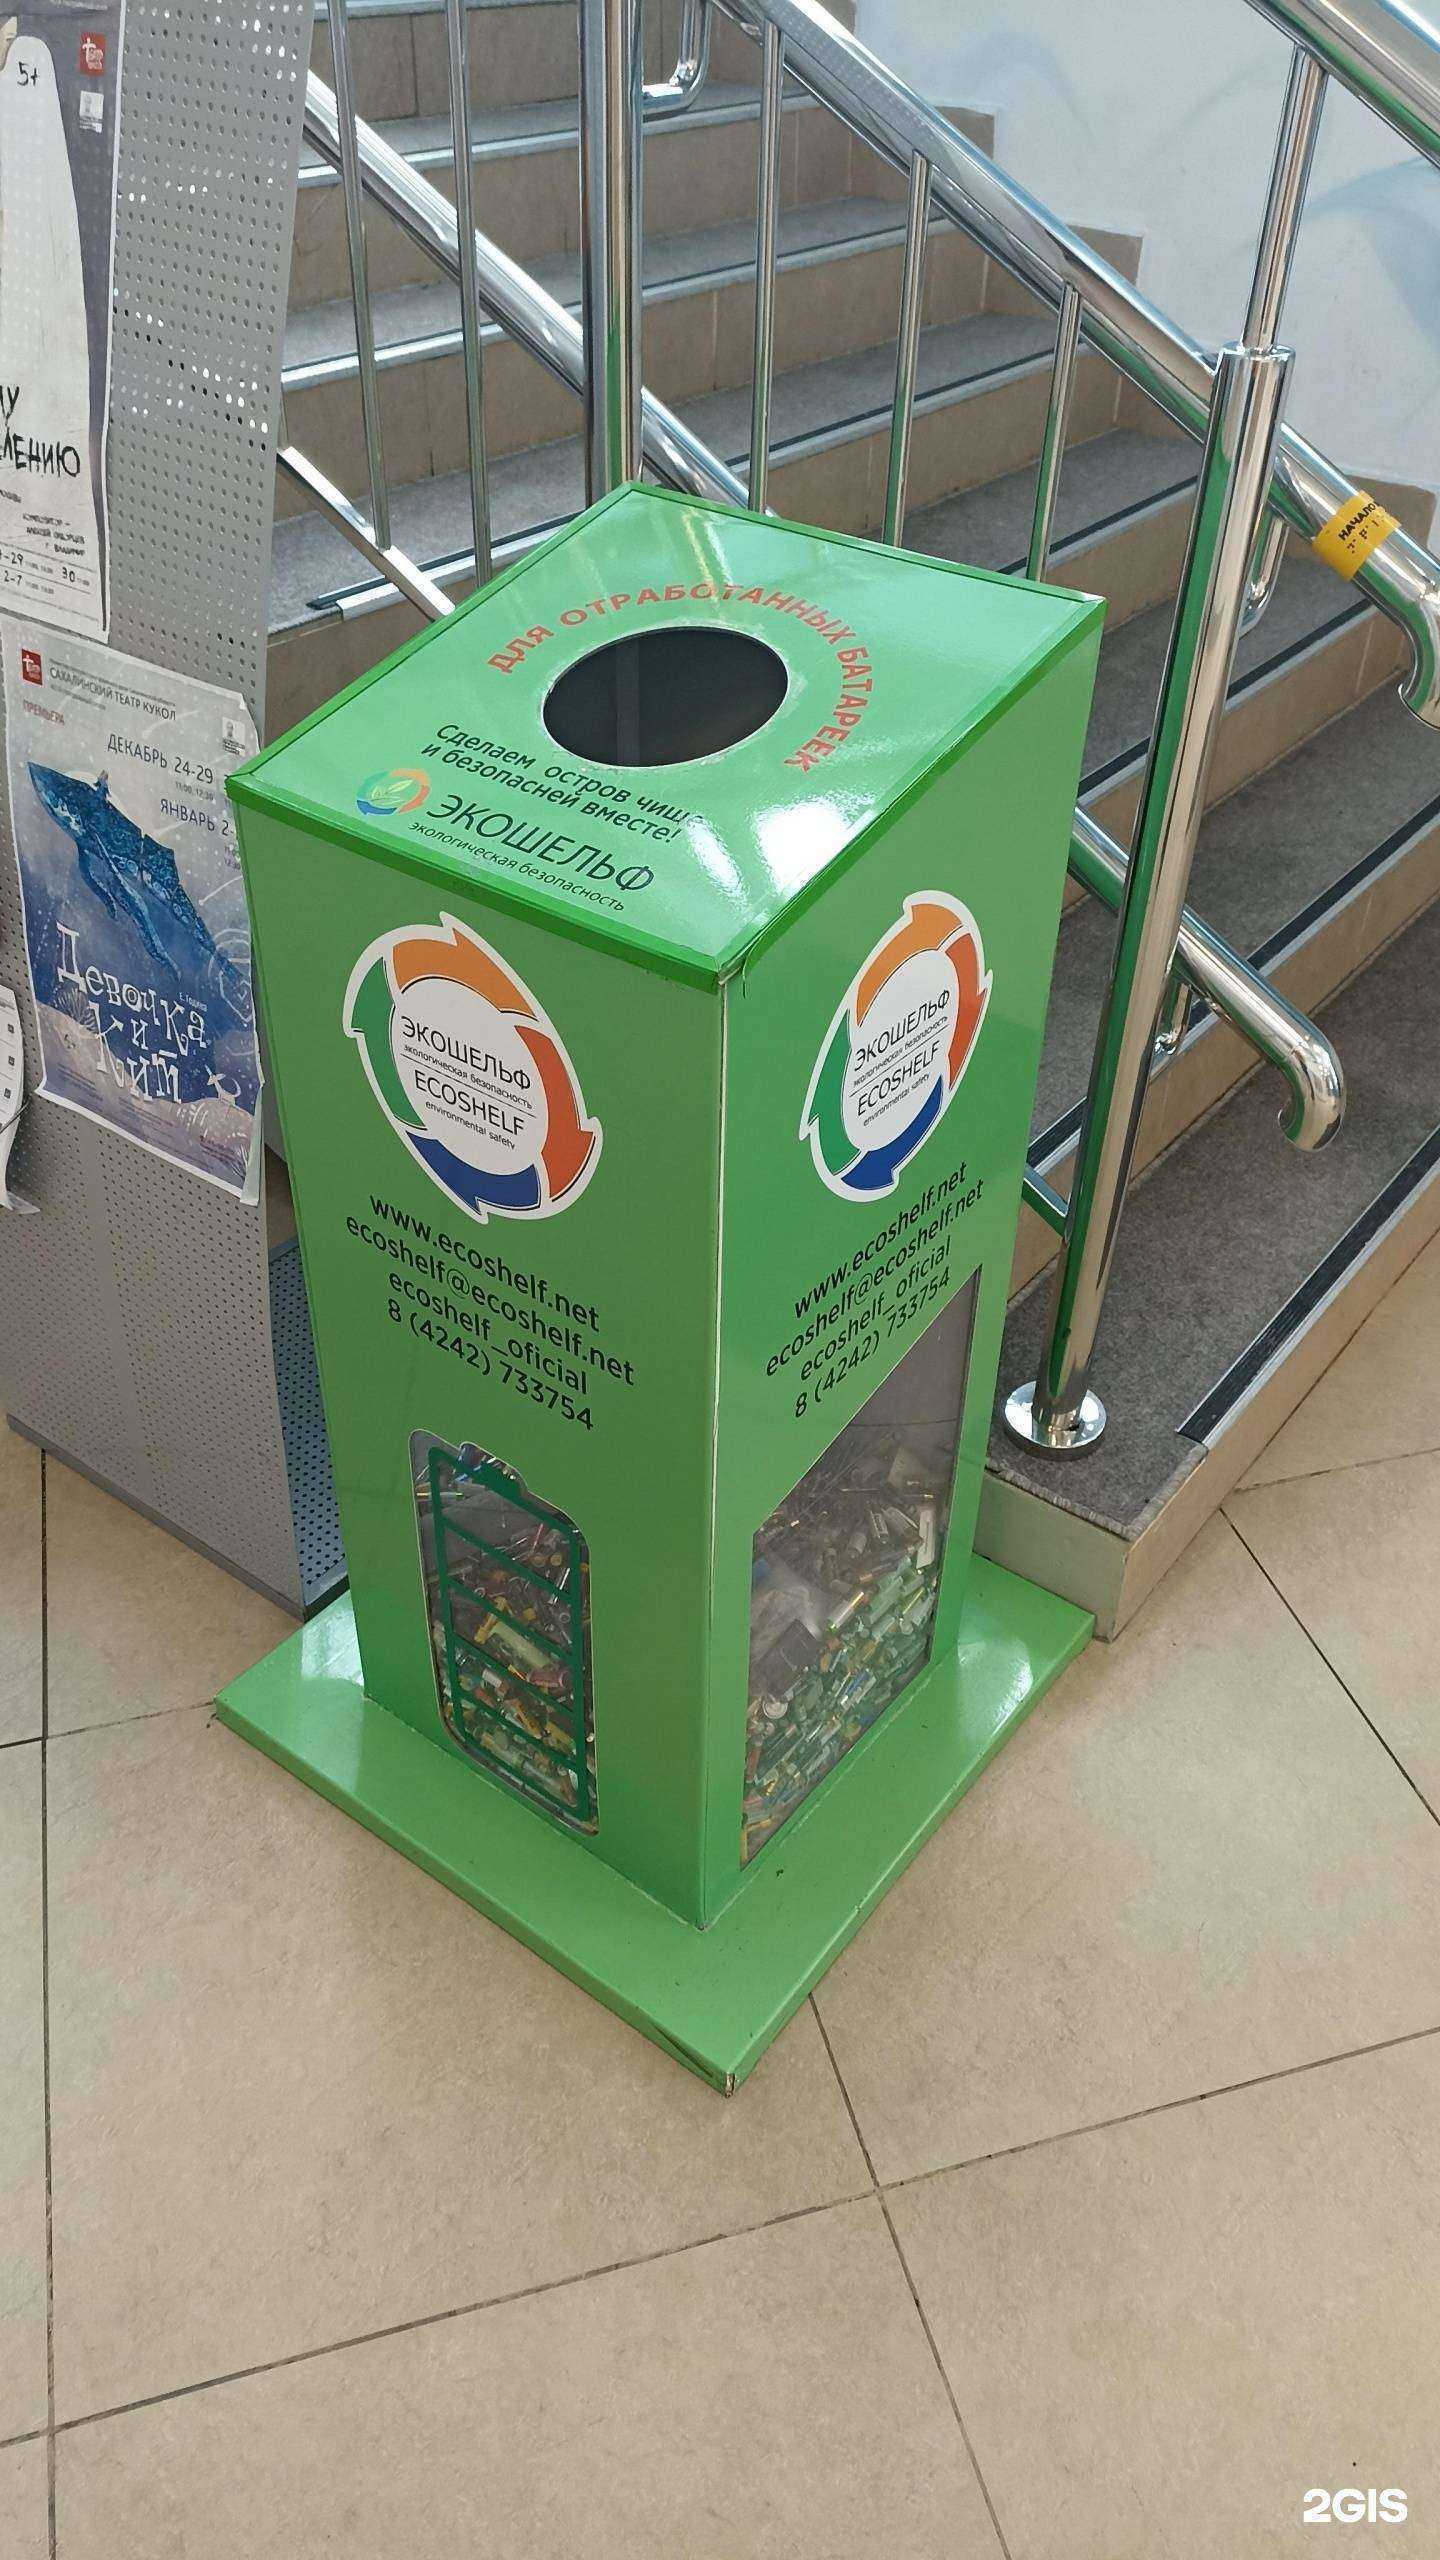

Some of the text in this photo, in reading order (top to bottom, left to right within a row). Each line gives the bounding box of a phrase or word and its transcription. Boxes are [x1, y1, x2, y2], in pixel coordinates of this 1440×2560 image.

[18, 61, 38, 87] 5+
[0, 427, 80, 477] ЛЕНИЮ
[49, 666, 113, 700] САХАЛИНСКИЙ
[115, 691, 141, 709] ТЕАТР
[143, 702, 176, 721] КУКОЛ
[487, 583, 873, 774] ДЛЯ ОТРАБОТАННЫХ БАТАРЕЕК
[107, 734, 214, 784] ДЕКАБРЬ 24-29
[421, 742, 682, 844] и безопасней вместе!
[436, 724, 537, 769] Сделаем
[544, 765, 632, 804] остров
[160, 798, 215, 832] ЯНВАРЬ
[425, 794, 655, 891] ЭКОШЕЛЬФ
[408, 821, 625, 912] экологическая безопасность
[56, 920, 208, 1057] Девочка
[854, 989, 951, 1072] ЭКОШЕЛЬФ
[400, 1015, 532, 1091] ЭКОШЕЛЬФ
[403, 1044, 533, 1110] экологическая безопасность
[857, 1040, 941, 1117] ECOSHELF
[414, 1069, 525, 1136] ECOSHELF
[425, 1100, 516, 1151] environmental safety
[863, 1086, 910, 1127] environmental
[369, 1194, 600, 1333] www.ecoshelf.net
[765, 1178, 984, 1377] ecoshelf@ecoshelf.net
[793, 1160, 967, 1320] www.ecoshelf.net
[346, 1216, 635, 1386] ecoshelf@ecoshelf.net
[388, 1271, 587, 1395] ecoshelf_oficial
[794, 1265, 951, 1419] 8 (4242) 733754
[800, 1234, 951, 1382] ecoshelf_oficial
[387, 1298, 594, 1431] 8 (4242) 733754
